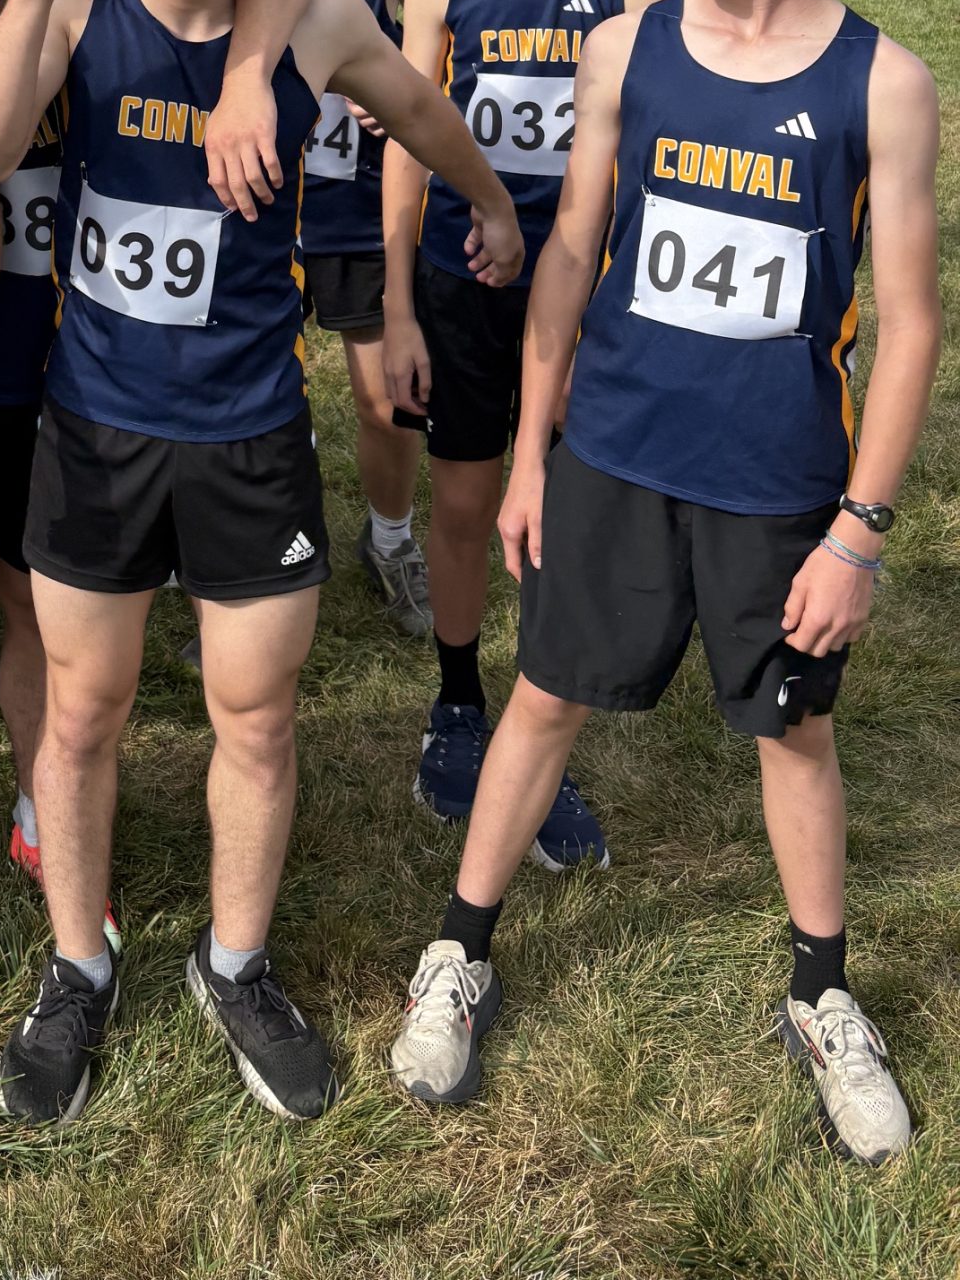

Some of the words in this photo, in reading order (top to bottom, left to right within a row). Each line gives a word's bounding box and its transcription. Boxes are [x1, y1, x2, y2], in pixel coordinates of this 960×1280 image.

[117, 95, 209, 147] CONV
[472, 97, 575, 152] 032
[654, 137, 801, 203] CONVAL
[80, 216, 205, 298] 039
[648, 230, 786, 319] 041
[281, 545, 315, 566] adidas
